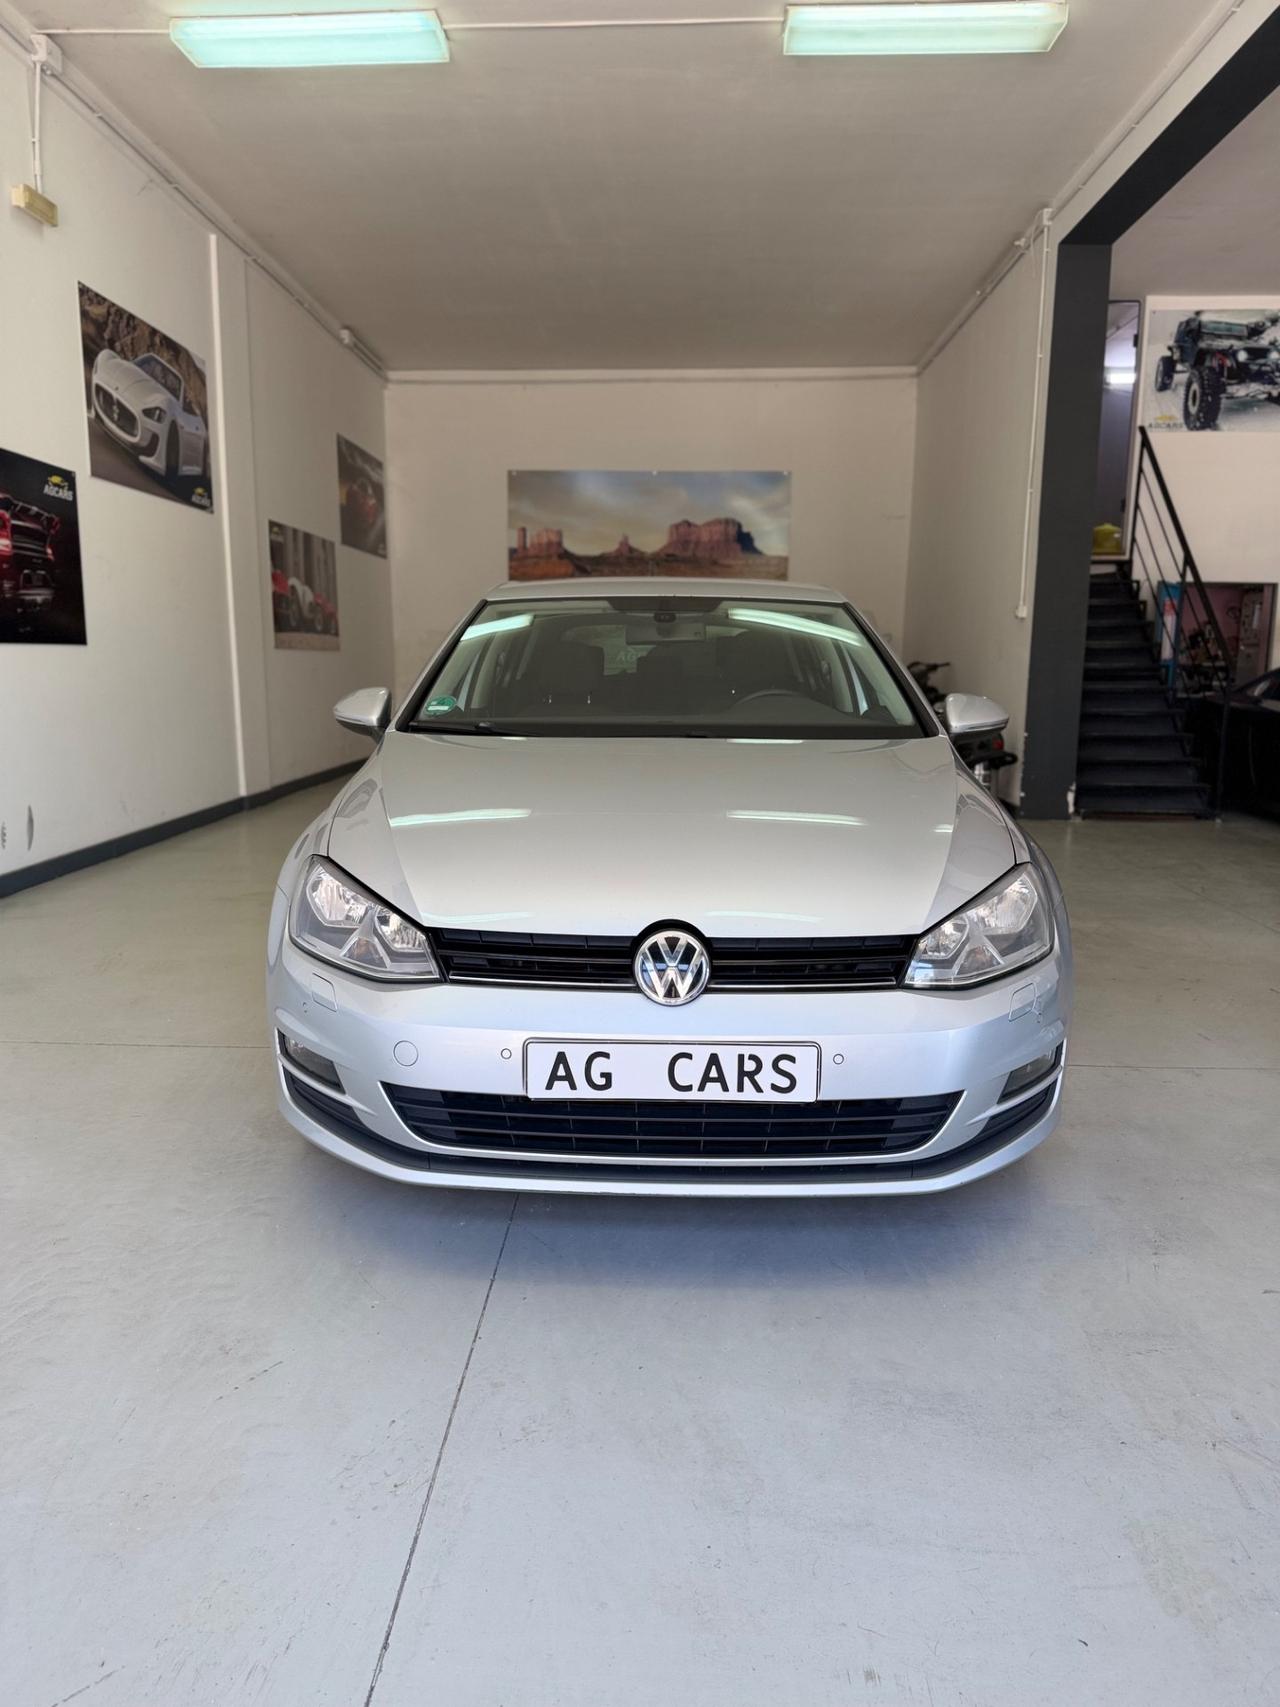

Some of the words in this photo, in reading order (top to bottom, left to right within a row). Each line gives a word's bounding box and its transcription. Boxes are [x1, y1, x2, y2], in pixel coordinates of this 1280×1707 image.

[638, 934, 706, 1001] VW
[545, 1051, 613, 1092] AG
[667, 1052, 797, 1094] CARS
